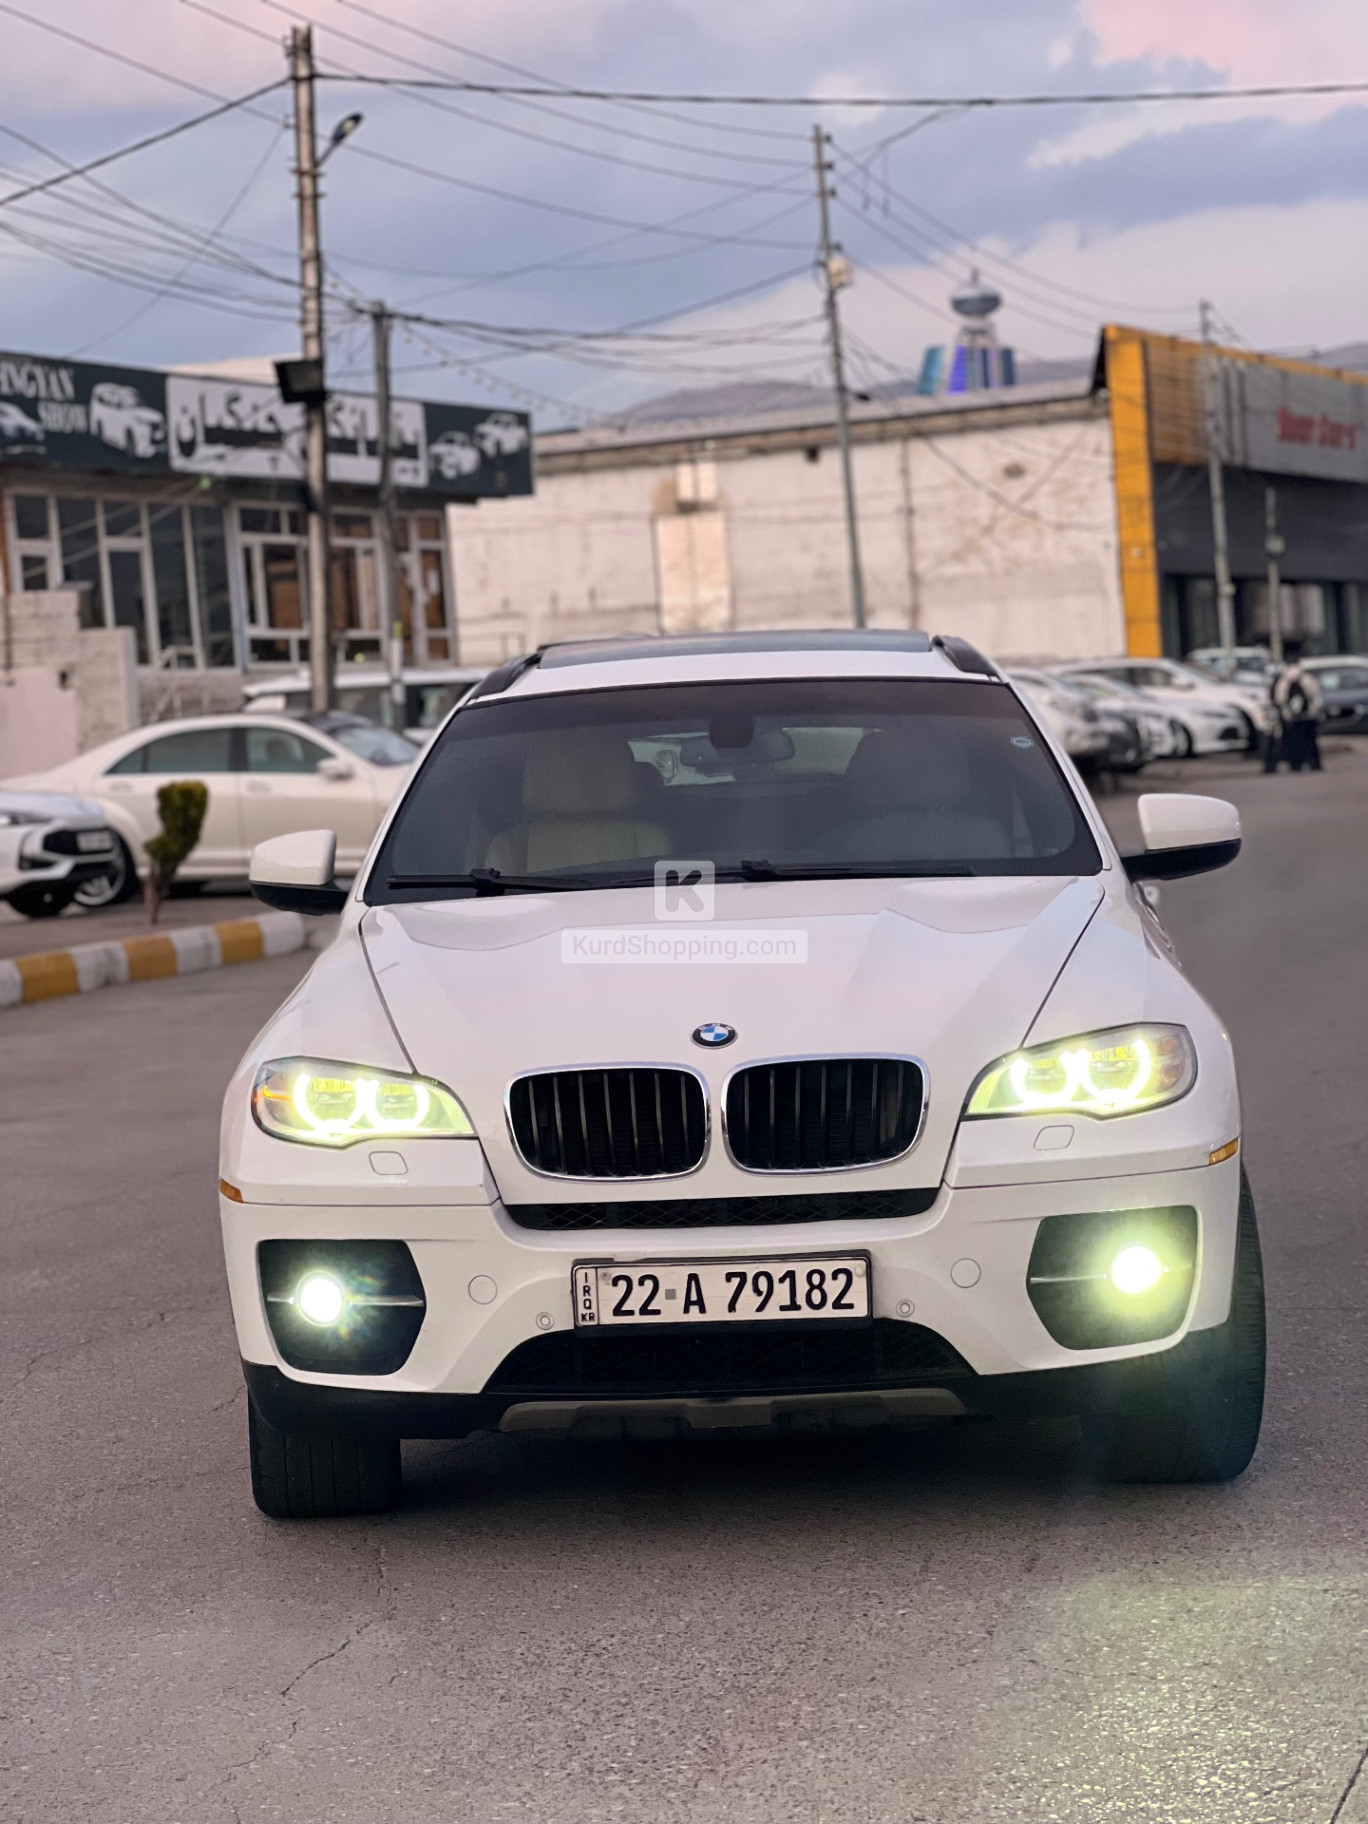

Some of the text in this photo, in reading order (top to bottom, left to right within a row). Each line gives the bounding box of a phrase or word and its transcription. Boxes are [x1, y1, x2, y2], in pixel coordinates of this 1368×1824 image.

[611, 1267, 855, 1317] 22 A 79182
